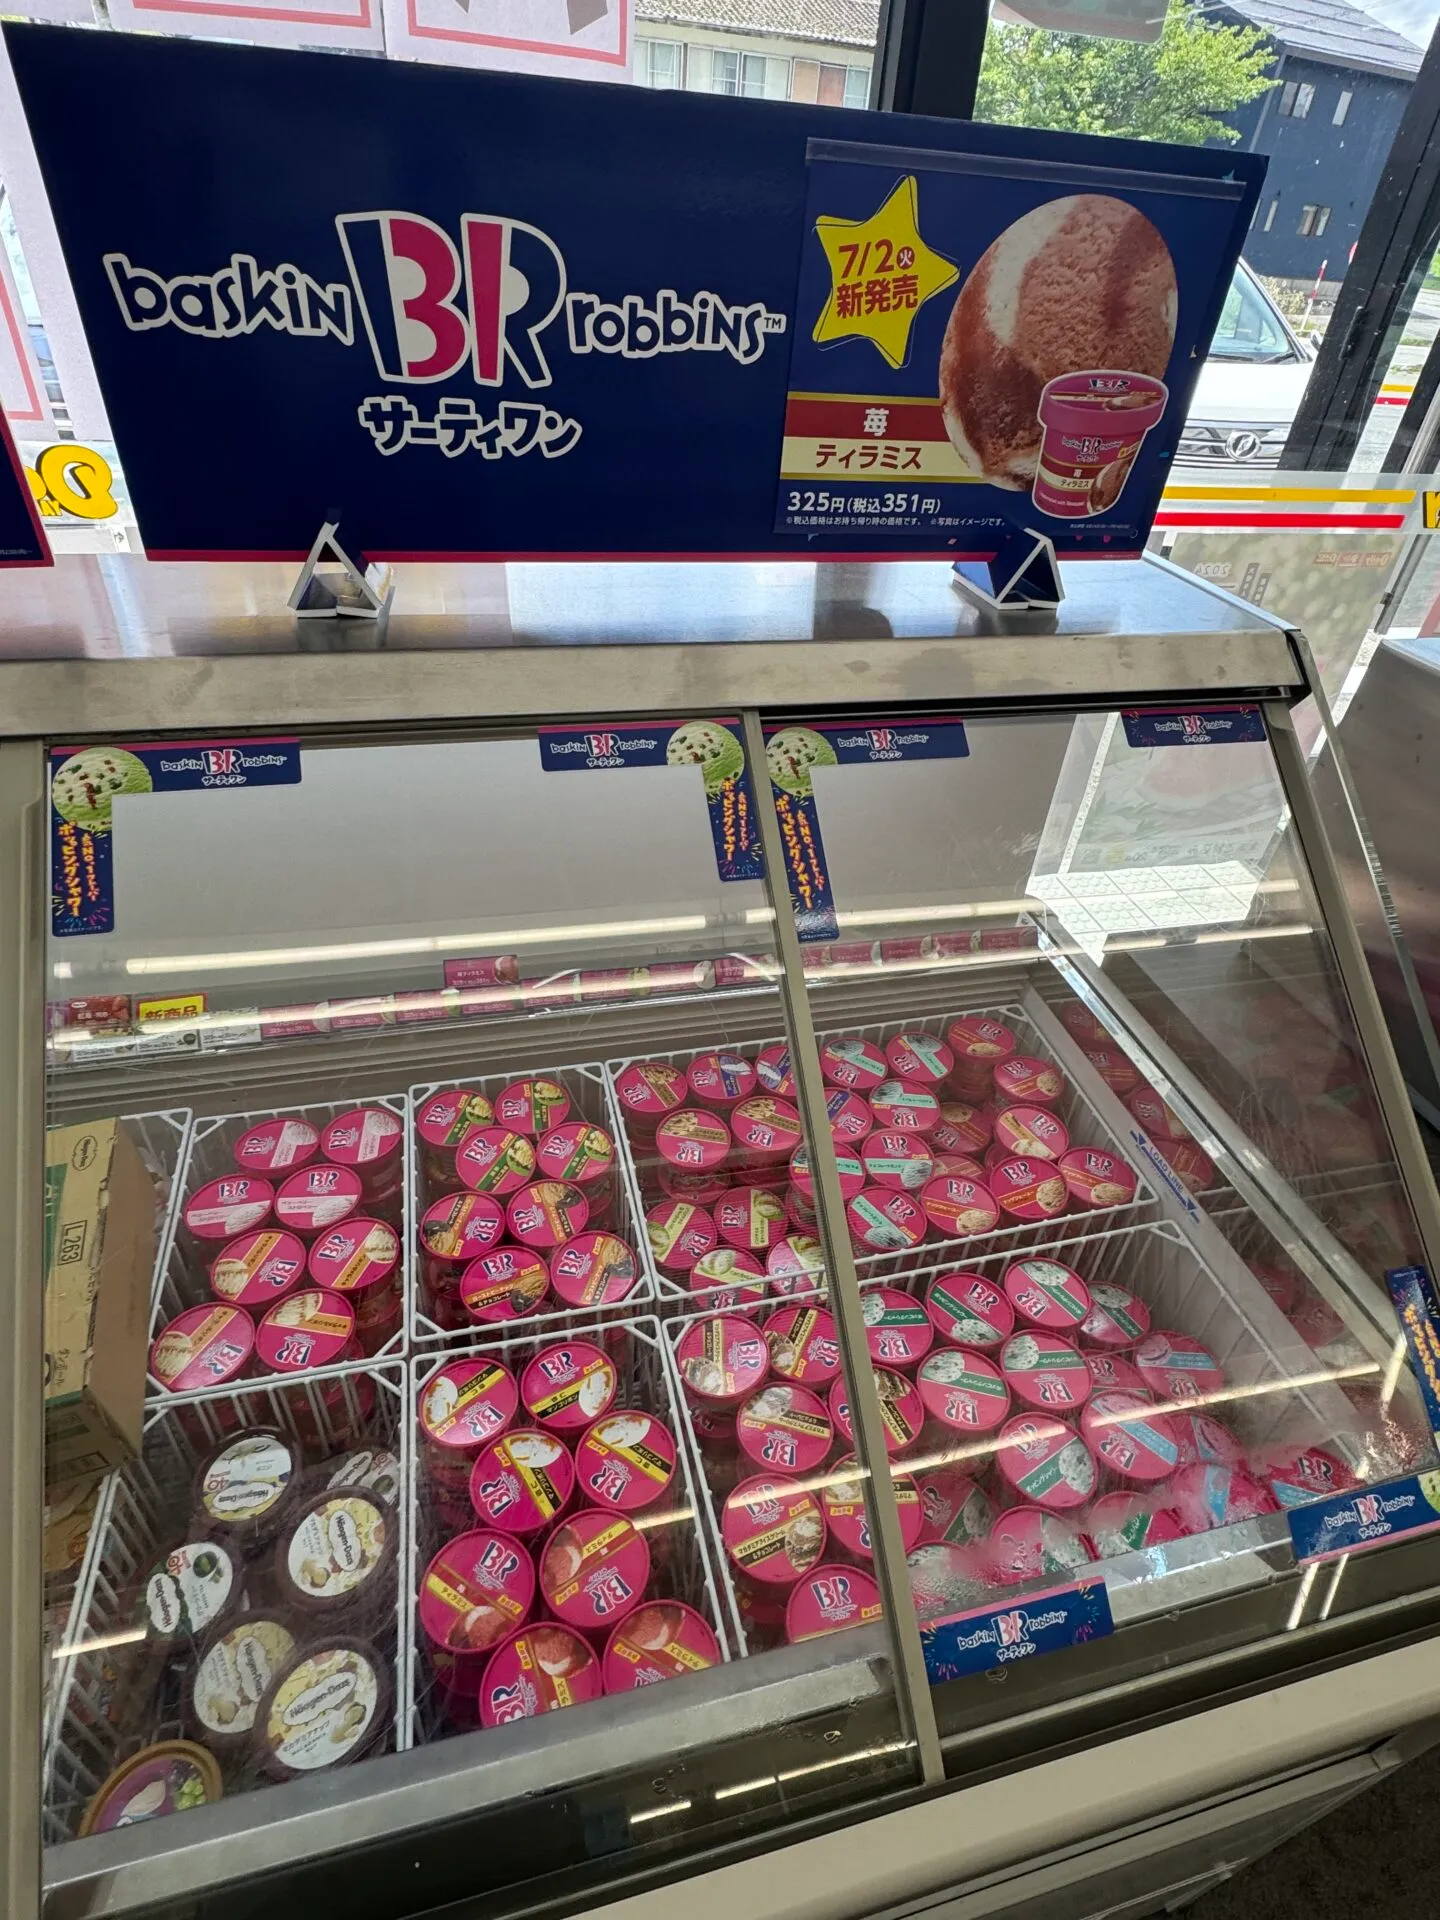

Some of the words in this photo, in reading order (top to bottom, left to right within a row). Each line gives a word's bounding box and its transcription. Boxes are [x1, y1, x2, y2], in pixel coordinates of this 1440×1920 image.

[103, 253, 355, 346] baskin
[335, 211, 566, 389] BR
[837, 275, 920, 319] 新発売
[359, 397, 582, 459] サーティワン
[863, 407, 890, 437] 苺
[815, 444, 922, 471] ティラミス
[550, 742, 587, 754] baskin
[584, 734, 619, 757] BR
[161, 759, 203, 772] baskin
[201, 749, 243, 775] BR
[586, 757, 624, 767] サーティワン
[202, 775, 247, 785] サーティワン
[1150, 1146, 1169, 1174] LOAD
[539, 1352, 575, 1379] BR
[471, 1406, 504, 1438] BR
[762, 1438, 796, 1467] BR
[1100, 1441, 1137, 1470] BR
[1298, 1456, 1333, 1481] BR
[479, 1477, 514, 1518] BR
[590, 1467, 628, 1503] BR
[1324, 1510, 1357, 1529] baskin
[1352, 1494, 1384, 1524] BR
[336, 1515, 355, 1566] Häagen-Dazs
[1358, 1523, 1391, 1538] サーティワン
[479, 1540, 520, 1583] BR
[155, 1578, 173, 1628] Häagen-Dazs
[593, 1573, 633, 1616] BR
[811, 1576, 851, 1609] BR
[957, 1630, 996, 1650] baskin
[991, 1610, 1029, 1645] BR
[997, 1643, 1036, 1662] サーティワン
[288, 1679, 350, 1718] Häagen-Dazs
